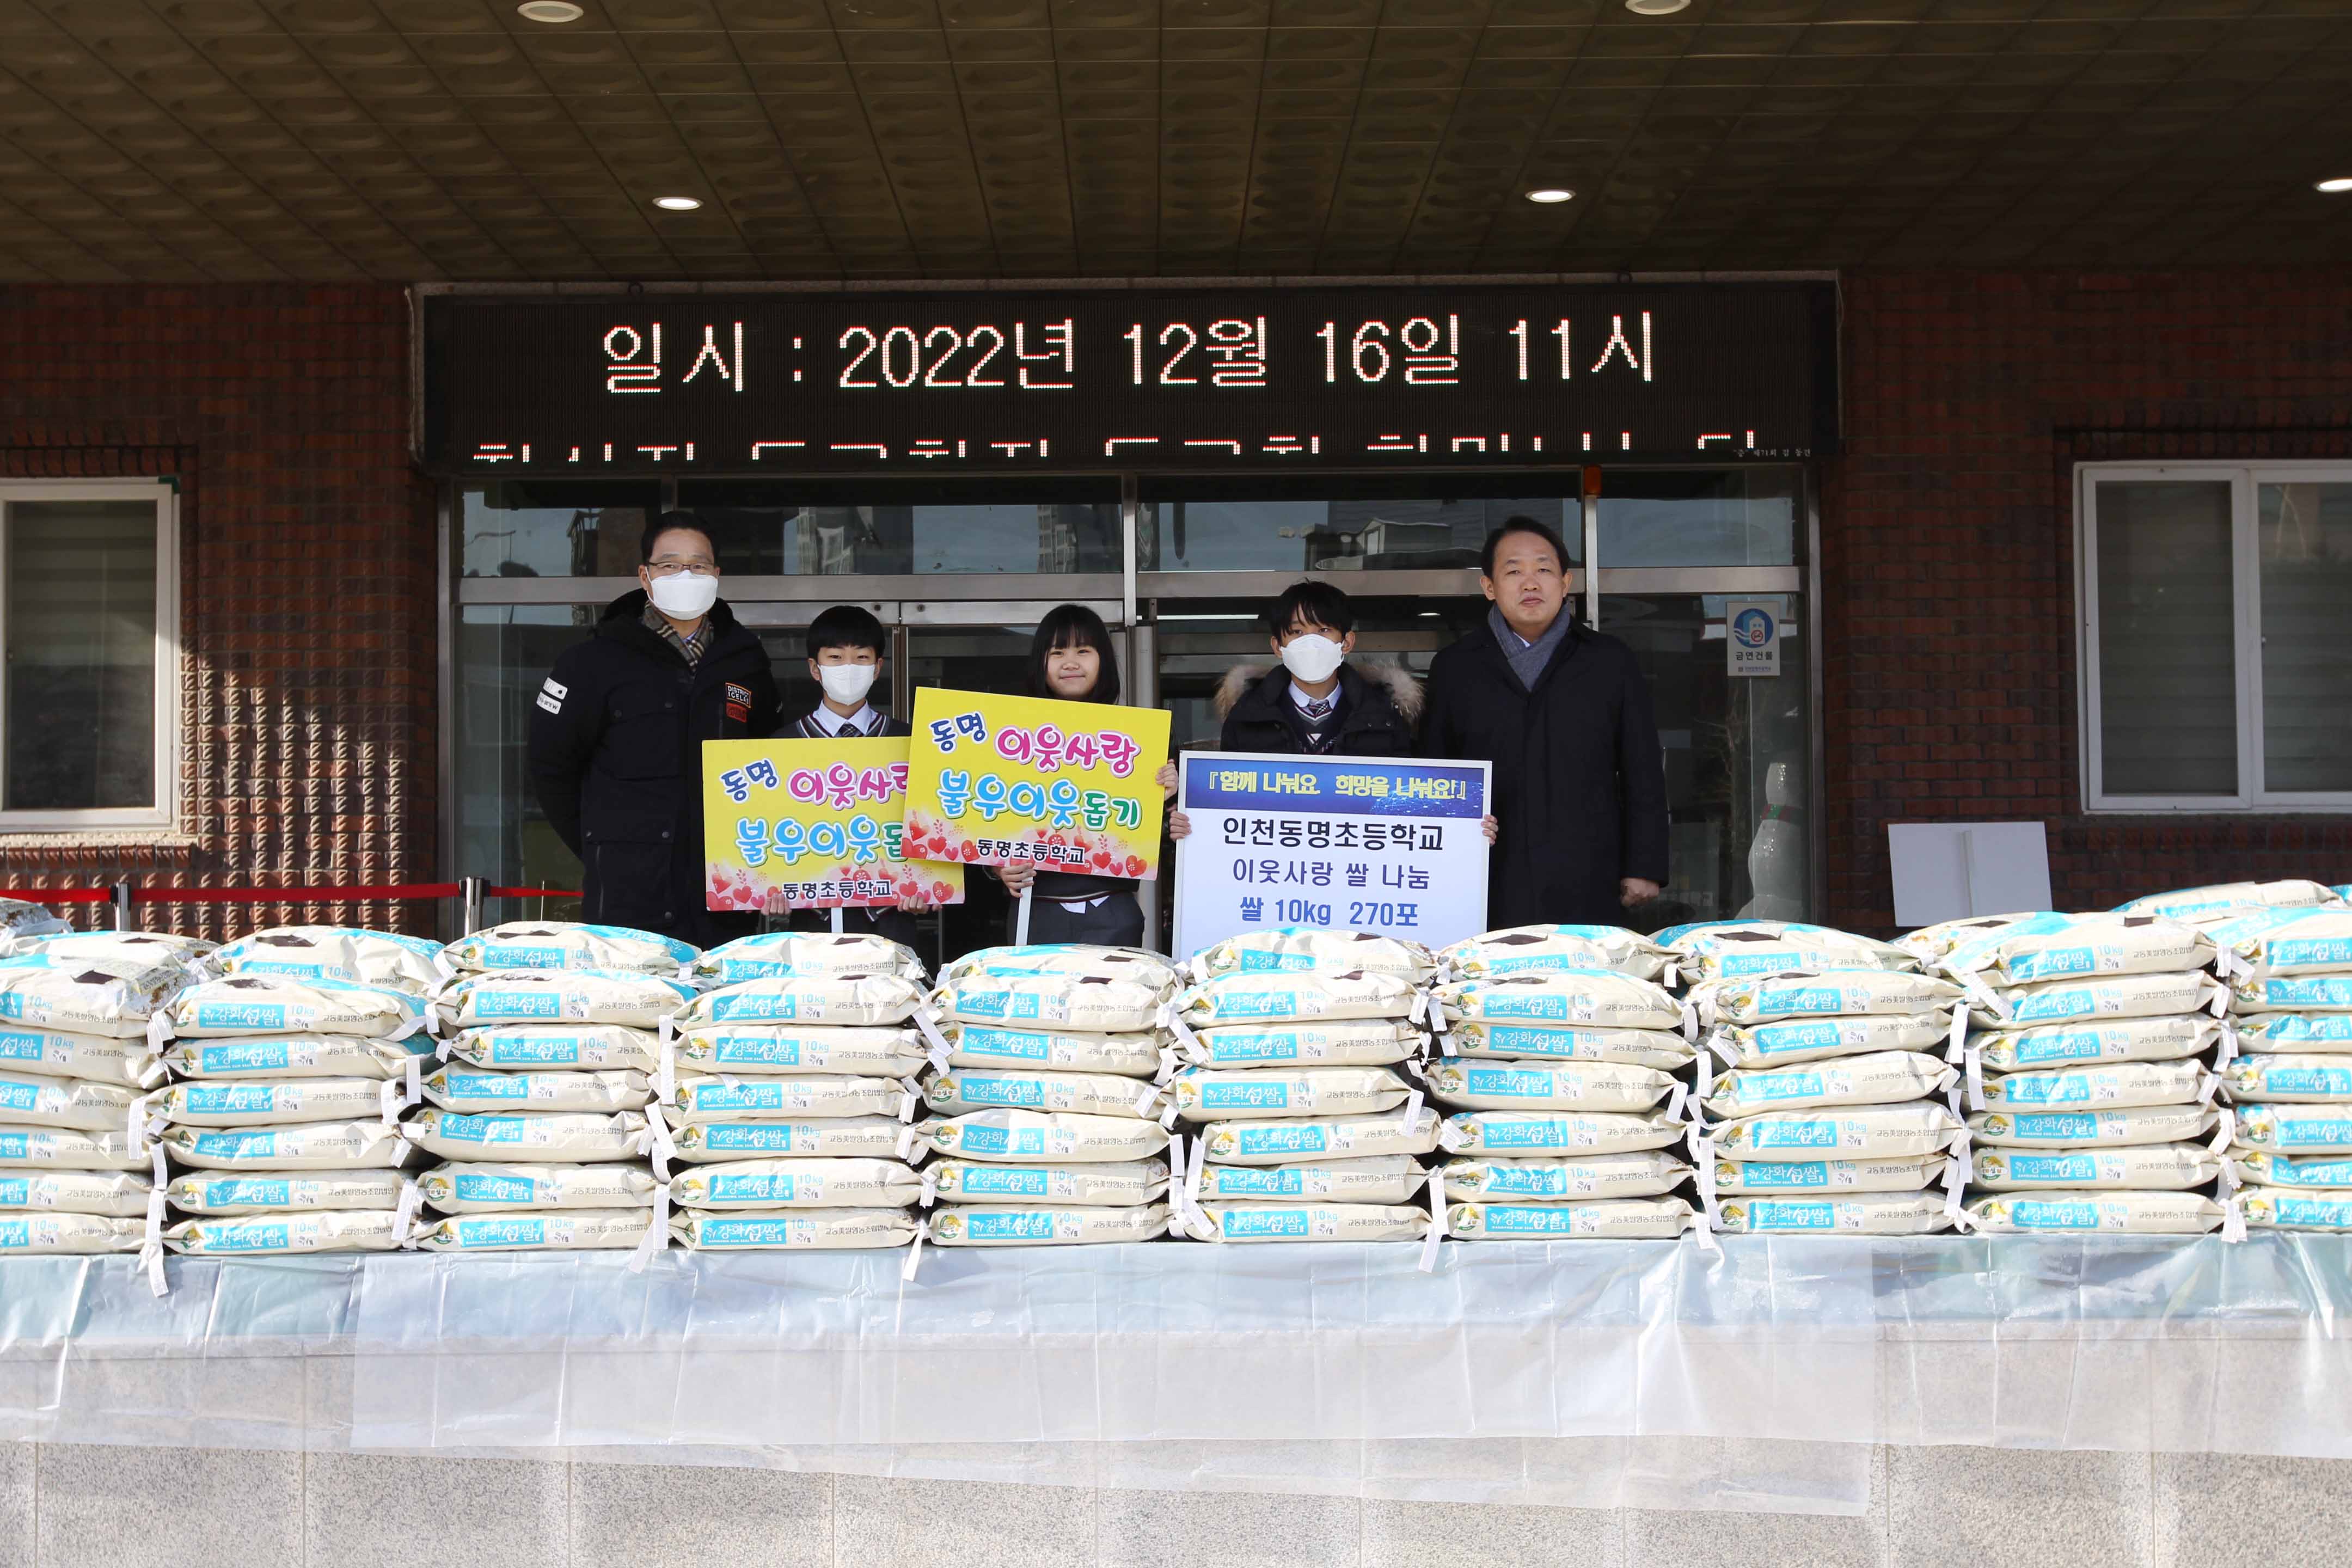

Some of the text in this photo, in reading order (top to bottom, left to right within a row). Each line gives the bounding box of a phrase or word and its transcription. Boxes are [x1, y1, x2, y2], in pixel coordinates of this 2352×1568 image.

[604, 311, 1652, 393] 일시 : 2022년 12월 16일 11시
[1736, 651, 1773, 660] 금연건물
[930, 712, 1141, 777] 동명 이웃사랑
[721, 759, 779, 801] 동명
[1336, 774, 1389, 797] 희망을
[937, 769, 1142, 830] 불우이웃돕기
[736, 815, 906, 866] 불우이웃돕
[1223, 817, 1443, 851] 인천동명초등학교
[977, 838, 1086, 865] 동명초등학교
[1233, 858, 1430, 889] 이웃사랑 쌀 나눔
[782, 880, 892, 900] 동명초등학교
[1240, 897, 1419, 927] 쌀 10kg 270포
[571, 950, 593, 961] 10kg
[1573, 953, 1595, 963] 10kg
[2097, 945, 2123, 955] 10kg
[2286, 942, 2348, 960] 강화섬쌀
[801, 961, 823, 971] 10kg
[566, 993, 589, 1004] 10kg
[801, 994, 826, 1004] 10kg
[49, 1037, 74, 1049] 10kg
[981, 1034, 1041, 1055] 강화섬쌀
[1302, 1032, 1326, 1043] 10kg
[1507, 1031, 1603, 1052] 강화섬쌀 10kg
[2103, 1031, 2129, 1042] 10kg
[512, 1038, 608, 1059] 강화섬쌀 10kg
[805, 1041, 829, 1052] 10kg
[788, 1083, 812, 1094] 10kg
[1486, 1073, 1547, 1093] 강화섬쌀
[2092, 1075, 2118, 1086] 10kg
[278, 1087, 303, 1097] 10kg
[978, 1082, 1075, 1102] 강화섬쌀 10kg
[1220, 1087, 1280, 1104] 강화섬쌀
[530, 1118, 553, 1129] 10kg
[1502, 1127, 1561, 1144] 강화섬쌀
[1573, 1121, 1596, 1132] 10kg
[2032, 1113, 2126, 1136] 강화섬쌀 10kg
[33, 1133, 57, 1144] 10kg
[721, 1128, 783, 1147] 강화섬쌀
[796, 1126, 820, 1137] 10kg
[1049, 1129, 1075, 1140] 10kg
[1257, 1131, 1318, 1149] 강화섬쌀
[1769, 1126, 1830, 1144] 강화섬쌀
[1841, 1122, 1866, 1132] 10kg
[2099, 1155, 2125, 1166] 10kg
[798, 1175, 823, 1185] 10kg
[1307, 1168, 1331, 1179] 10kg
[1571, 1167, 1595, 1178] 10kg
[1759, 1161, 1855, 1184] 강화섬쌀 10kg
[294, 1180, 318, 1191] 10kg
[981, 1173, 1040, 1192] 강화섬쌀
[1242, 1211, 1338, 1233] 강화섬쌀 10kg
[1575, 1208, 1600, 1219] 10kg
[1766, 1203, 1864, 1225] 강화섬쌀 10kg
[2029, 1204, 2128, 1224] 강화섬쌀 10kg
[35, 1220, 59, 1230] 10kg
[294, 1224, 318, 1234] 10kg
[549, 1220, 574, 1229] 10kg
[718, 1224, 779, 1241] 강화섬쌀
[791, 1219, 816, 1229] 10kg
